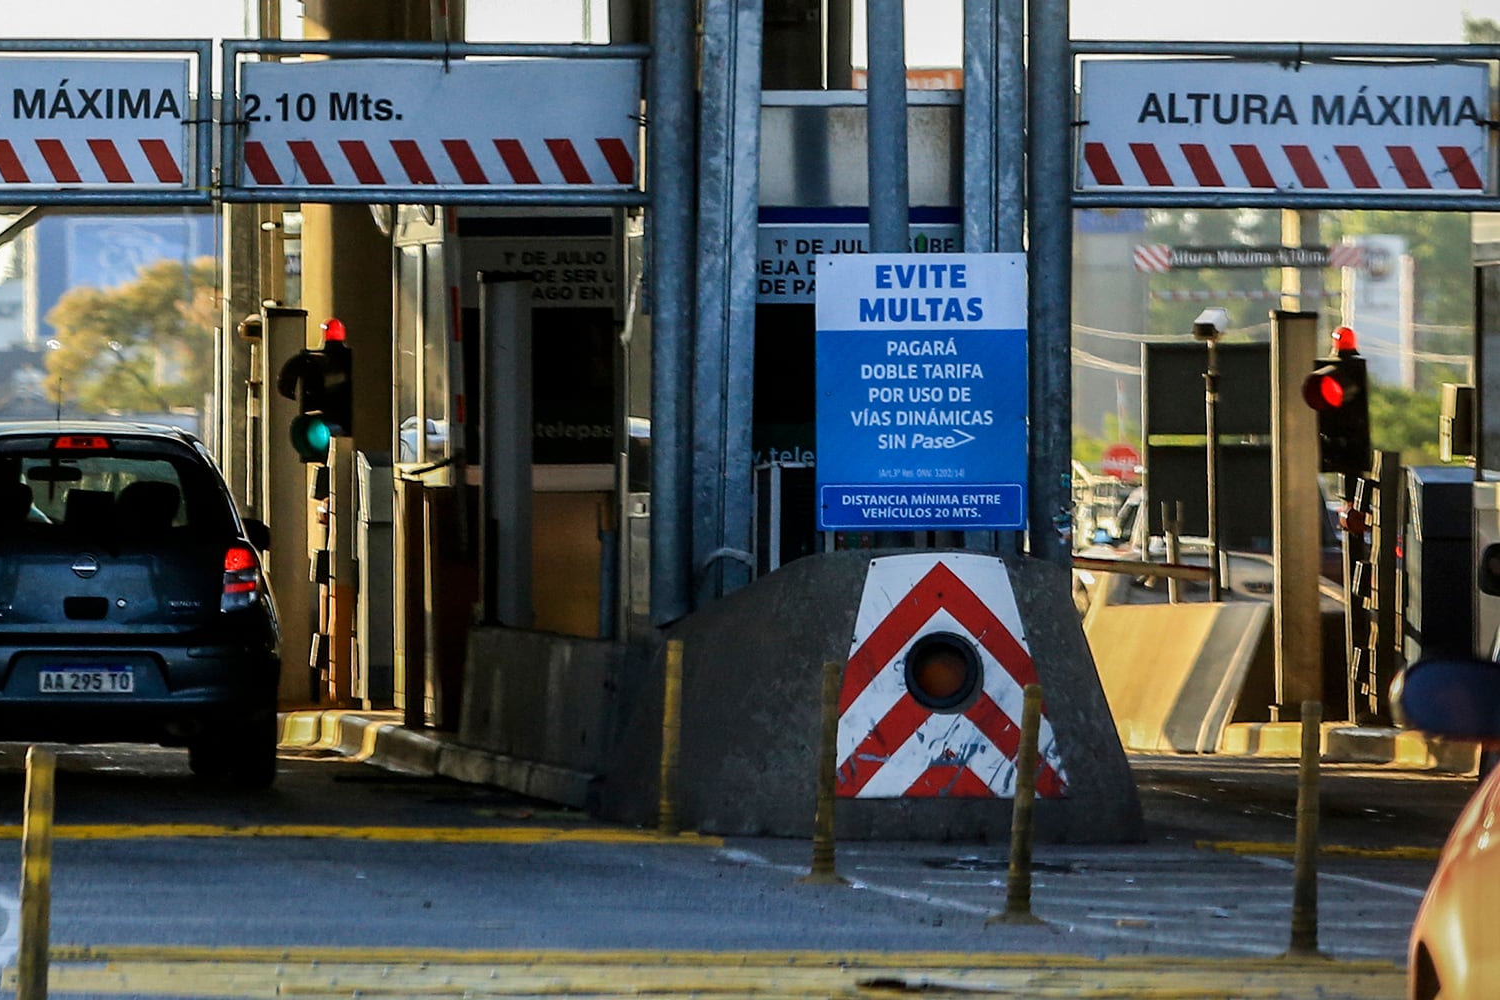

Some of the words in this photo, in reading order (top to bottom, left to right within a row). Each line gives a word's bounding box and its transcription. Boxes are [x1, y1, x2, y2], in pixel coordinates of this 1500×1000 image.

[13, 79, 182, 120] MÁXIMA
[243, 93, 316, 123] 2.10
[329, 93, 404, 123] Mts.
[1137, 92, 1298, 126] ALTURA
[1312, 85, 1480, 127] MÁXIMA
[795, 239, 824, 255] DE
[875, 263, 967, 289] EVITE
[759, 279, 787, 295] DE
[859, 296, 984, 322] MULTAS
[886, 336, 958, 356] PAGARÁ
[860, 363, 918, 380] DOBLE
[922, 363, 984, 379] TARIFA
[868, 386, 905, 403] POR
[909, 386, 944, 403] USO
[948, 386, 972, 402] DE
[850, 408, 892, 427] VÍAS
[895, 407, 994, 426] DINÁMICAS
[877, 433, 907, 450] SIN
[910, 432, 956, 450] Pase
[841, 494, 908, 506] DISTANCIA
[911, 491, 959, 505] MÍNIMA
[962, 494, 1001, 505] ENTRE
[861, 505, 933, 519] VEHÍCULOS
[935, 508, 950, 518] 20
[952, 507, 982, 518] MTS.
[43, 673, 65, 690] AA
[70, 673, 102, 690] 295
